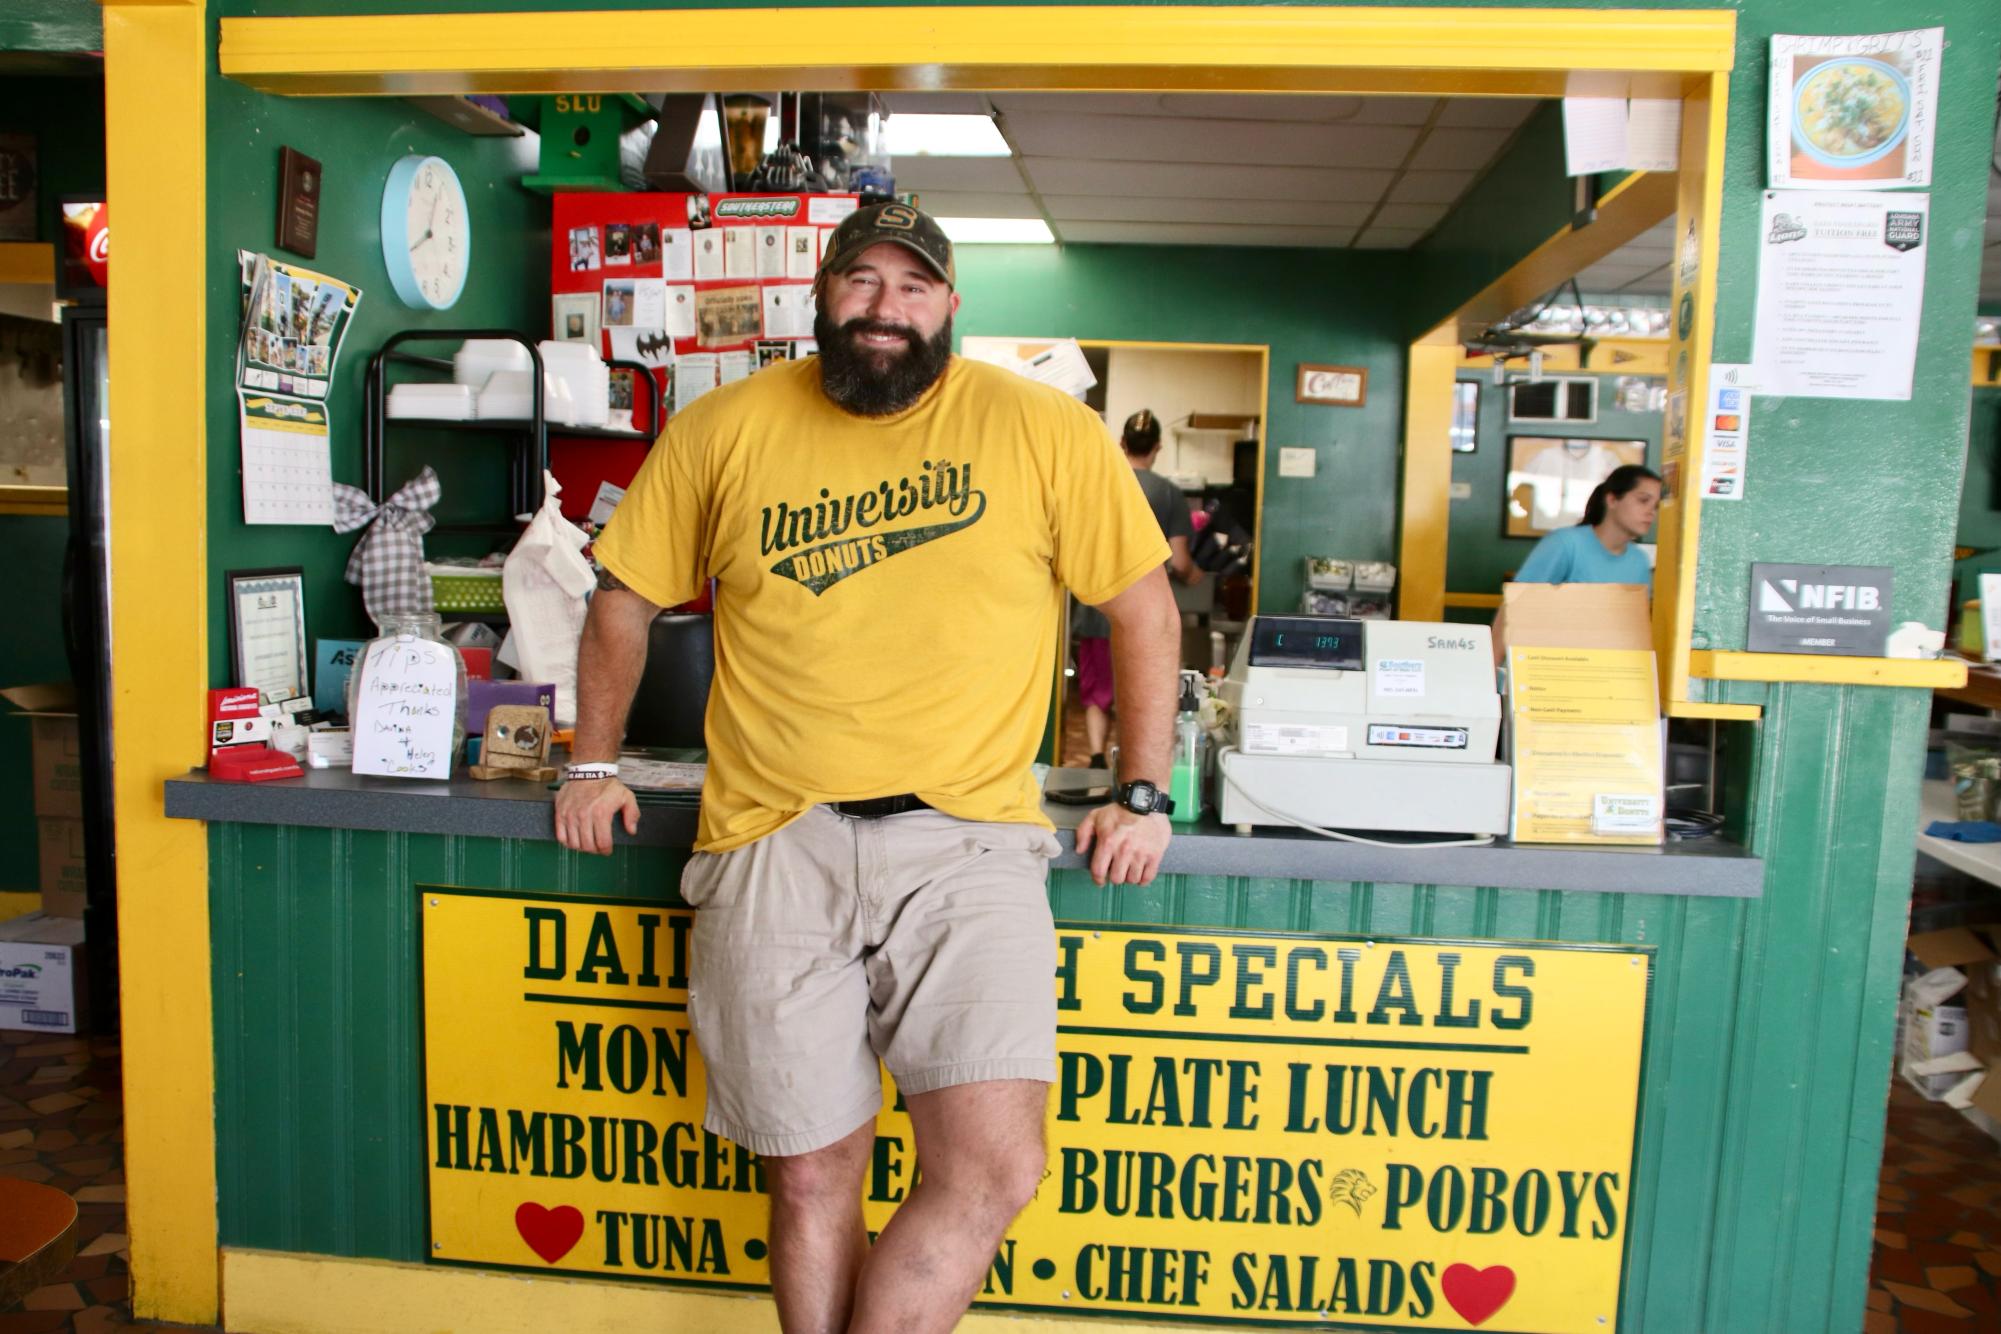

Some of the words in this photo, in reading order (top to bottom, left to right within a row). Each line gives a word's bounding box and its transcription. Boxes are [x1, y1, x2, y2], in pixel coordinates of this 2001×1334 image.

[556, 94, 601, 113] SLU
[1890, 219, 1919, 227] ARMY
[1889, 232, 1920, 240] GUARD
[761, 459, 980, 556] University
[792, 535, 888, 583] DONUTS
[1800, 584, 1881, 611] NFIB
[1767, 614, 1783, 623] The
[1784, 615, 1805, 624] Voice
[1806, 615, 1815, 624] of
[1816, 616, 1837, 625] Small
[1838, 617, 1872, 626] Business
[1800, 637, 1836, 647] MEMBER
[371, 641, 436, 675] Tips
[371, 676, 452, 697] Appreciated
[378, 700, 441, 717] Thanks
[407, 747, 435, 761] Helen
[1122, 939, 1536, 1031] SPECIALS
[1056, 1051, 1262, 1131] PLATE
[1284, 1062, 1494, 1141] LUNCH
[1058, 1147, 1324, 1227] BURGERS
[1381, 1163, 1620, 1241] POBOYS
[597, 1210, 731, 1276] TUNA
[1075, 1243, 1212, 1307] CHEF
[1231, 1251, 1436, 1319] SALADS
